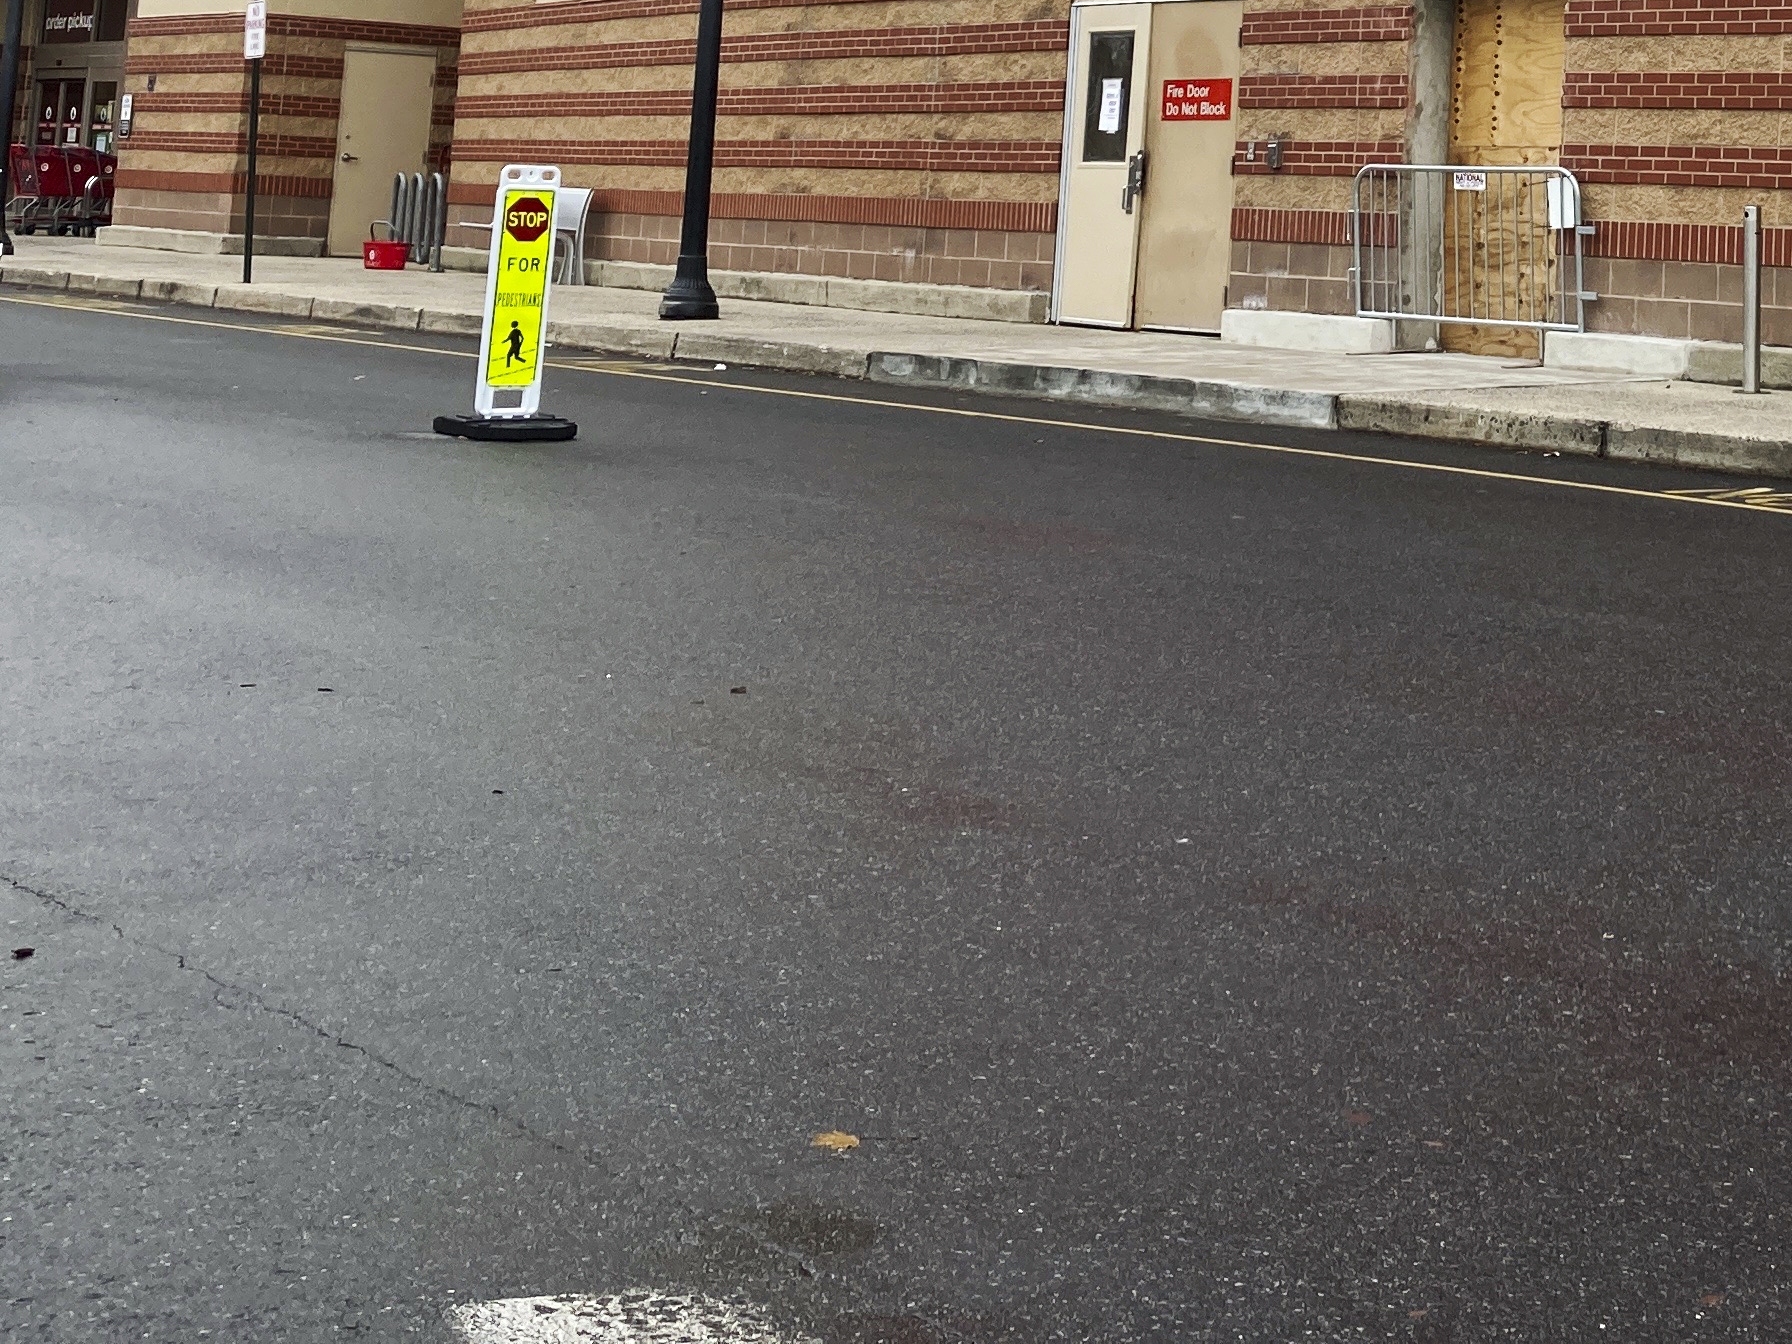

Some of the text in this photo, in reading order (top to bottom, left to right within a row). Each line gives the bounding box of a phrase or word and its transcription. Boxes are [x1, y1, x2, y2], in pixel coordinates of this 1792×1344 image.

[46, 11, 93, 32] order pickup
[1166, 84, 1210, 98] Fire Door
[1166, 102, 1226, 116] Do Not Block
[1456, 173, 1484, 182] NATIONAL
[508, 211, 547, 228] STOP
[507, 257, 540, 271] FOR
[495, 292, 542, 307] PEDESTRIANS
